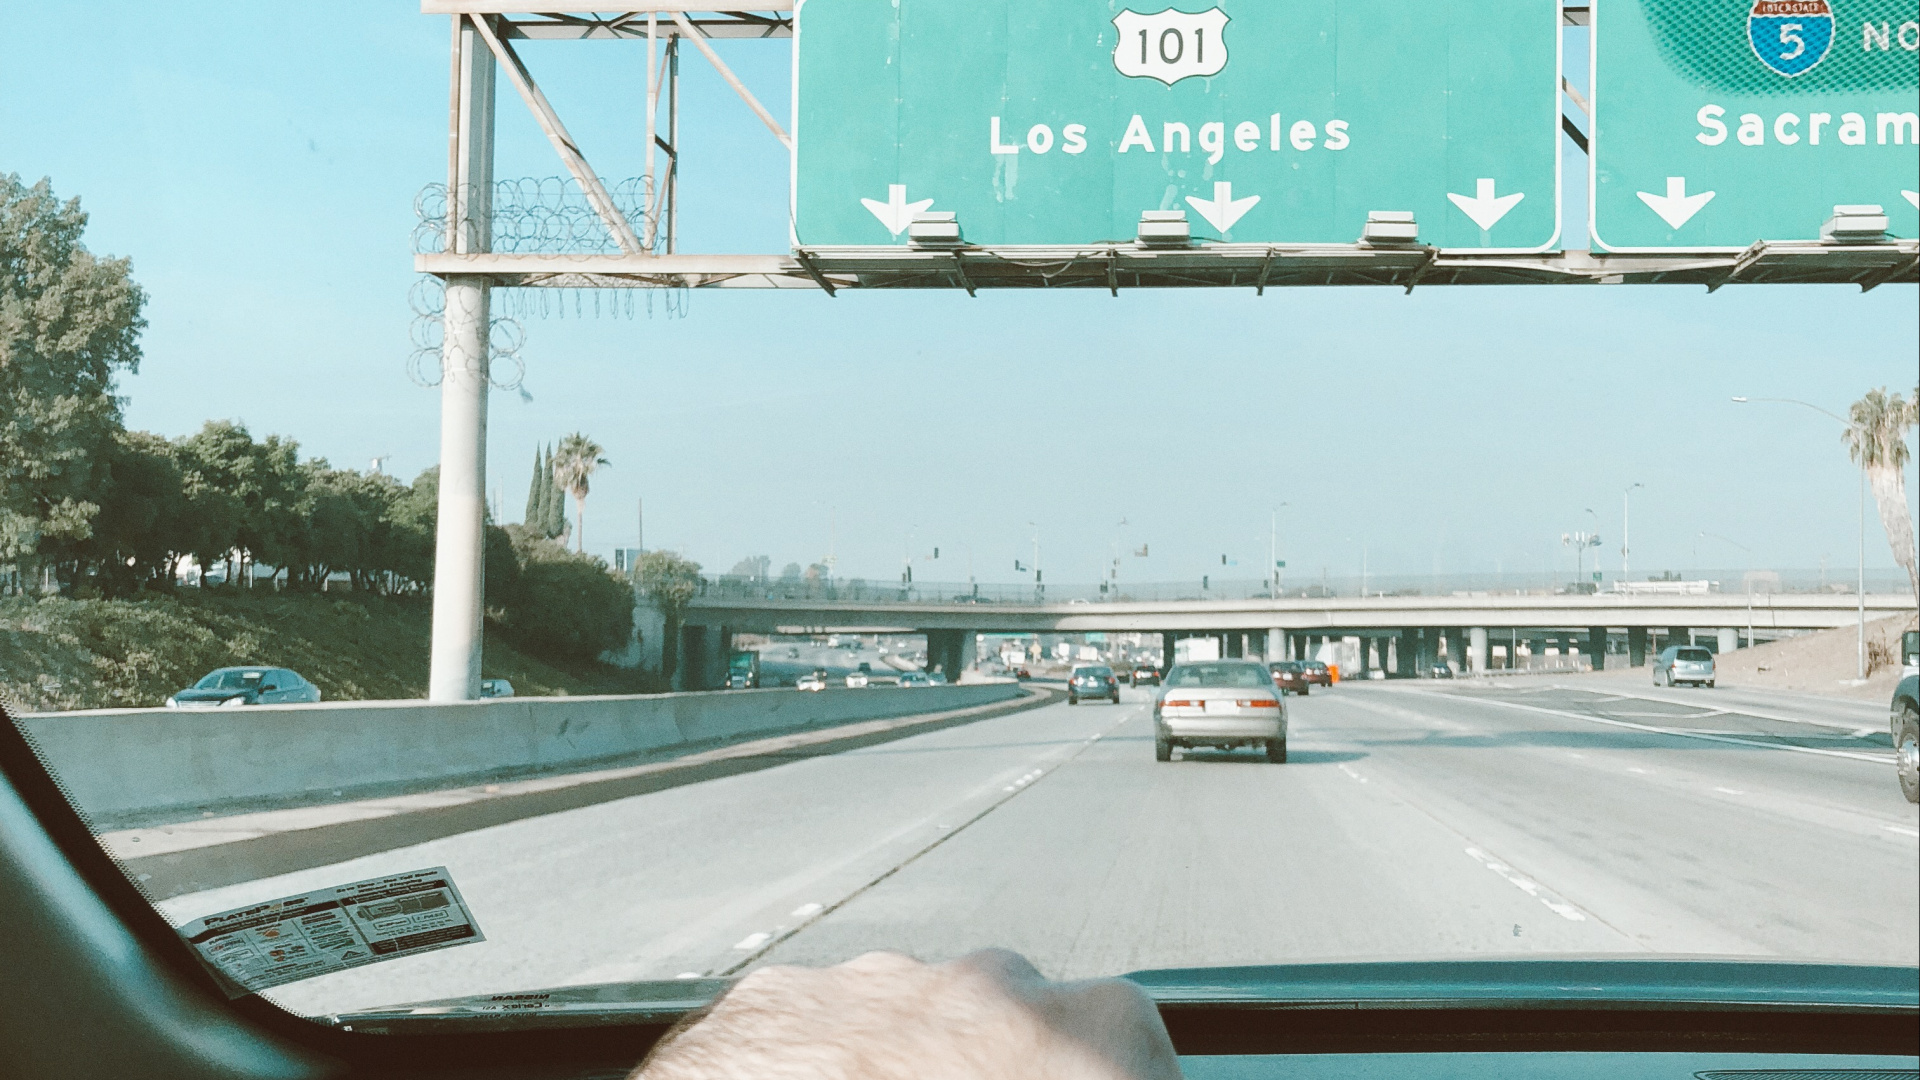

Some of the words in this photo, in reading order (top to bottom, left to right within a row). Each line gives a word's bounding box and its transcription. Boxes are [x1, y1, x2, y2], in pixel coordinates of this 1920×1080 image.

[1138, 28, 1204, 65] 101
[1780, 24, 1805, 60] 5
[990, 117, 1087, 155] Los
[1118, 112, 1351, 165] Angeles
[1695, 104, 1919, 146] Sacram
